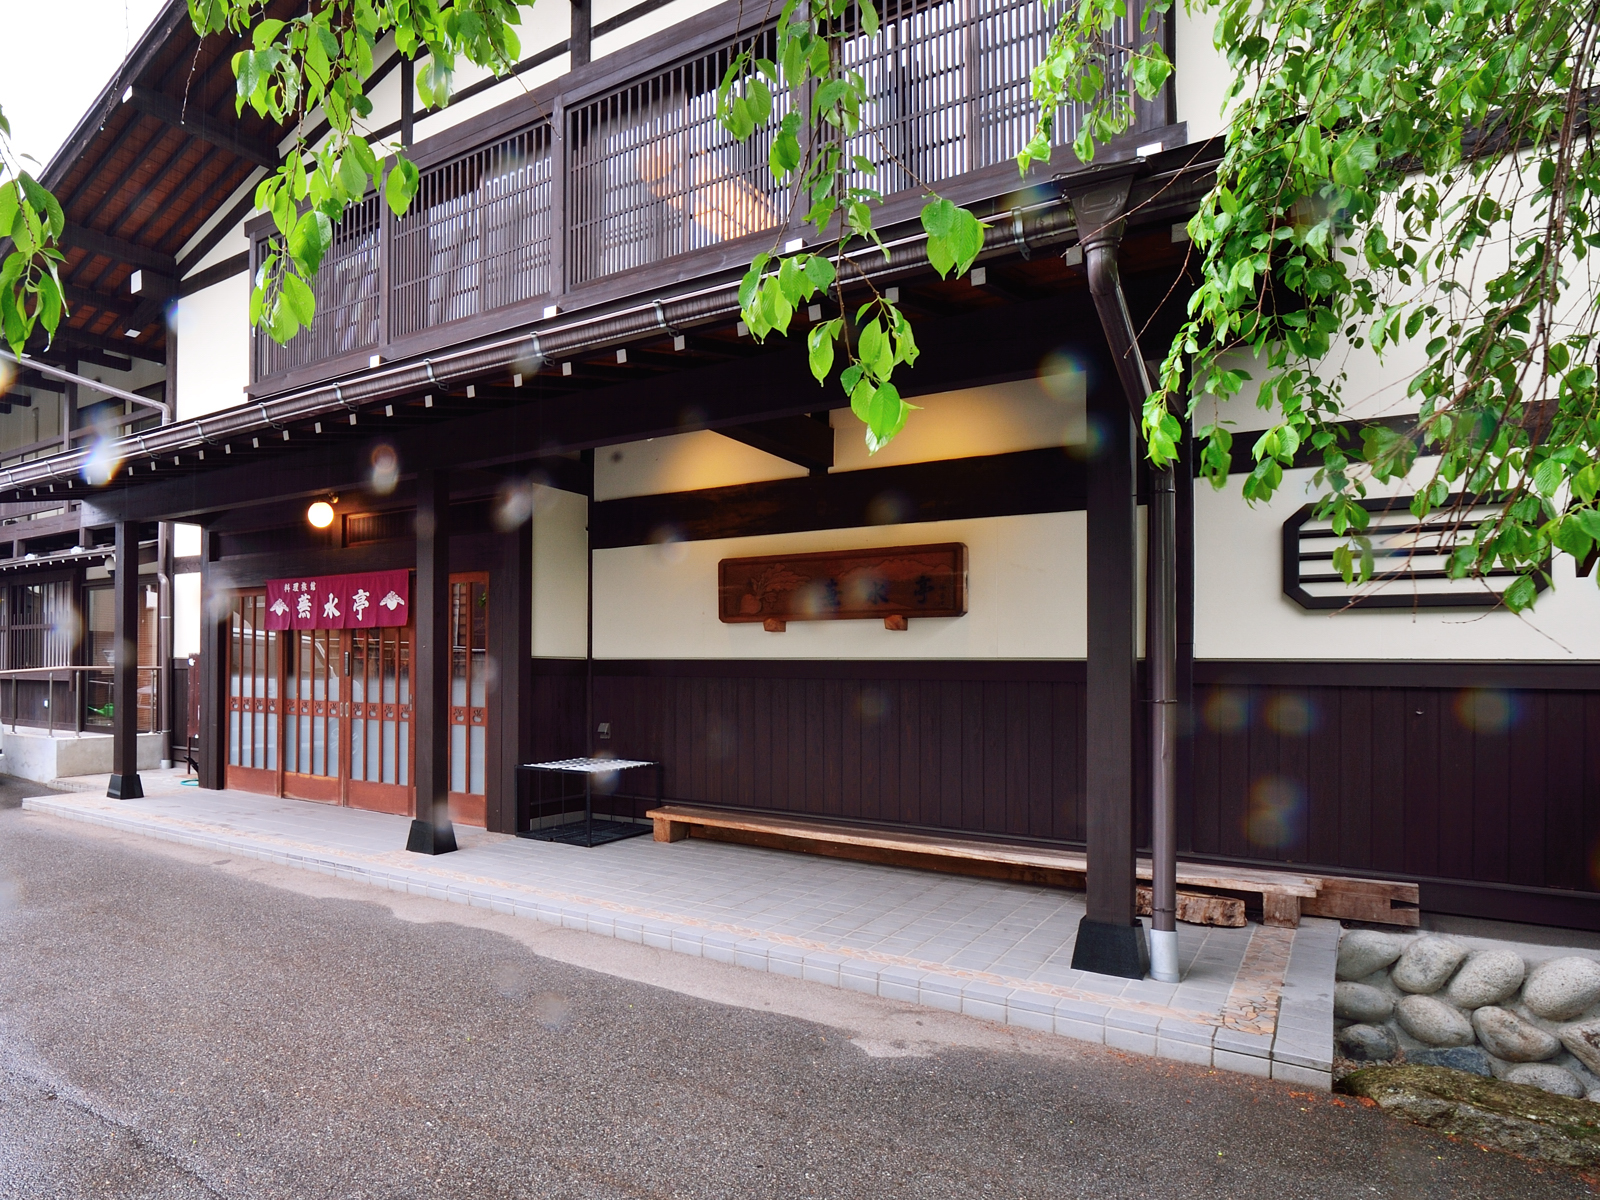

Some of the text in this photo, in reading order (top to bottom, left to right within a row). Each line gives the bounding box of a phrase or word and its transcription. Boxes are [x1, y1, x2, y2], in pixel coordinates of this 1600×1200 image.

[284, 581, 317, 593] 料理旅館
[296, 588, 370, 621] 蕪水亭
